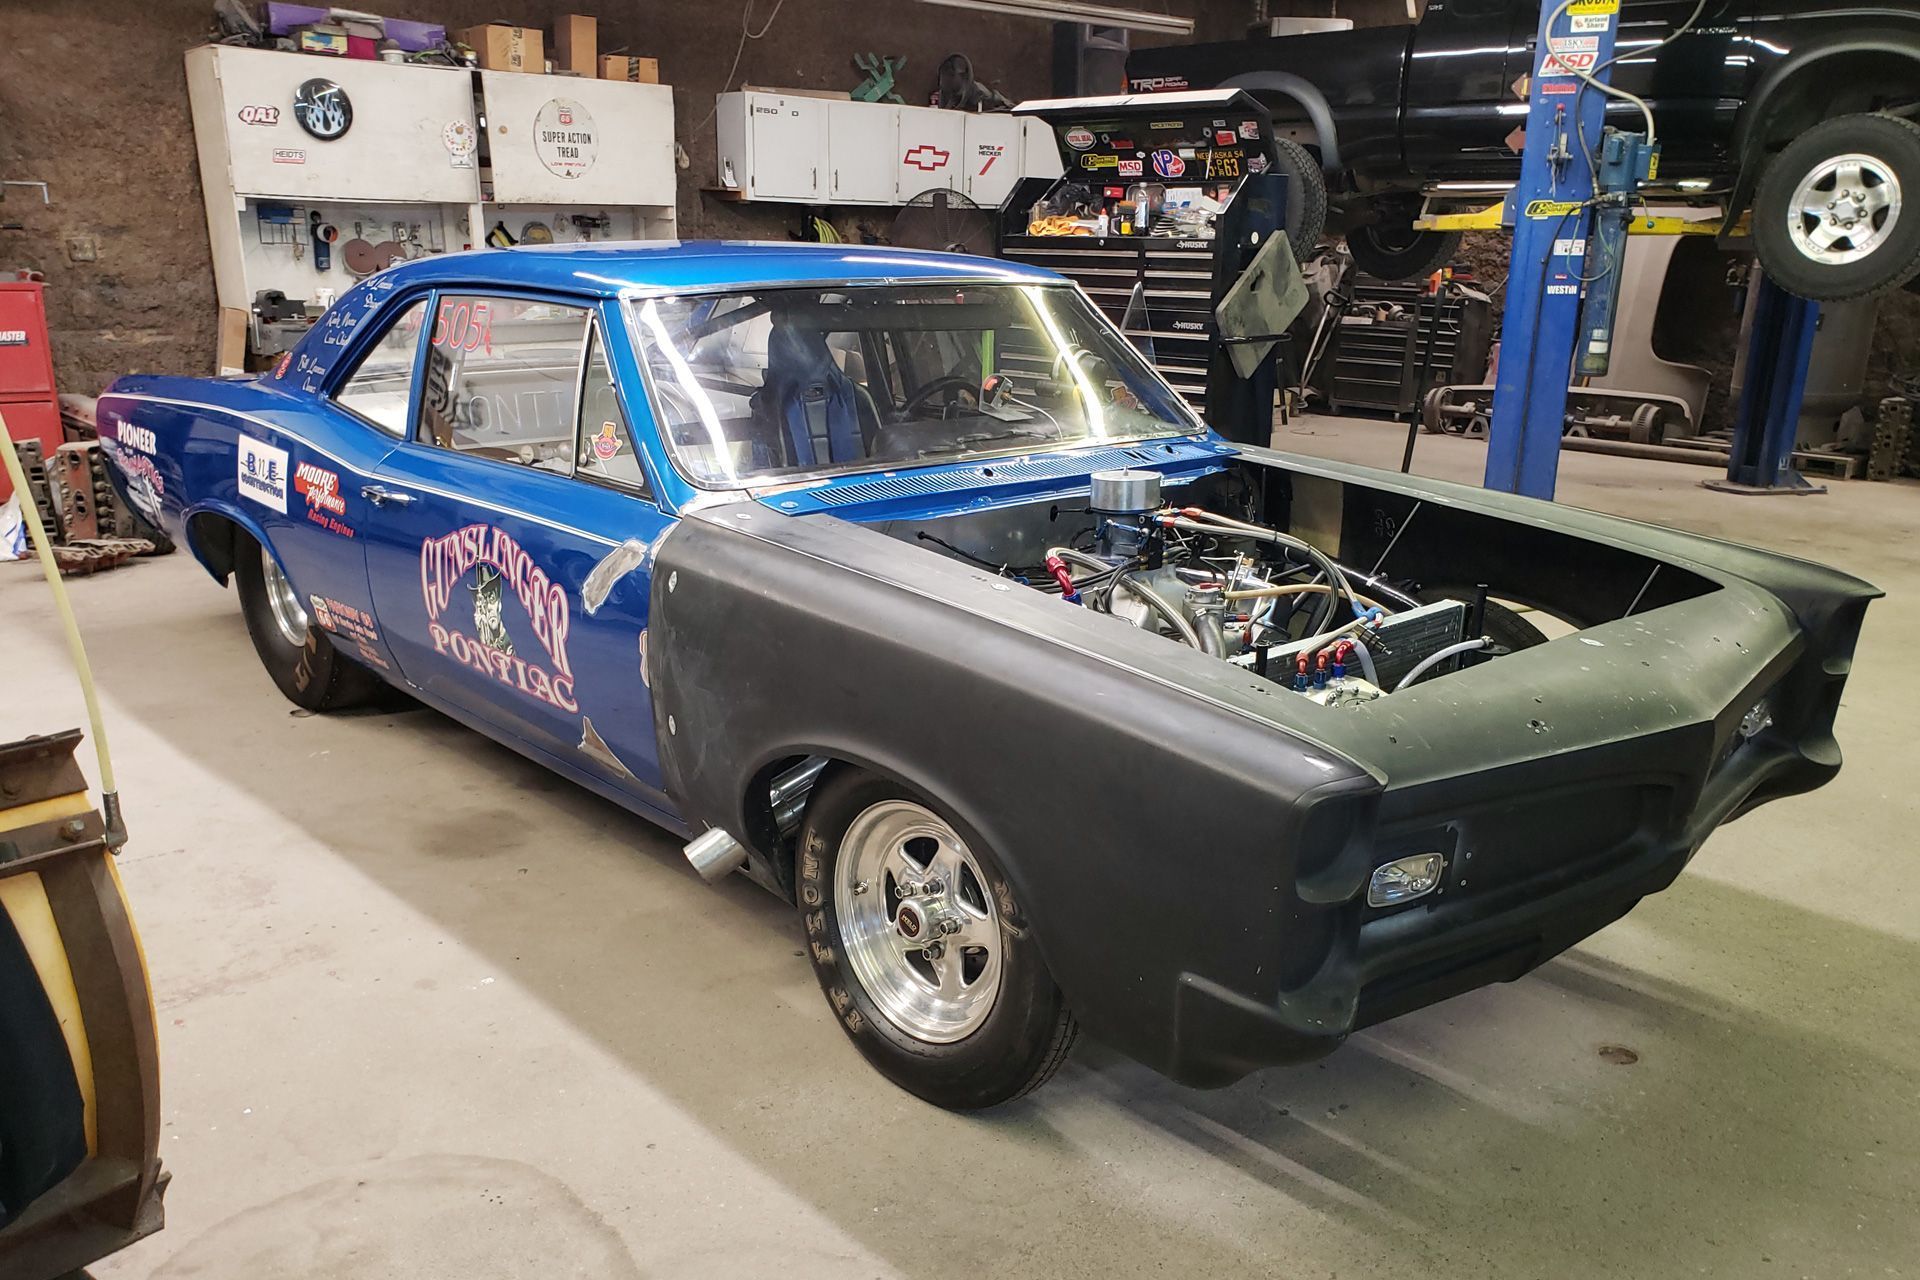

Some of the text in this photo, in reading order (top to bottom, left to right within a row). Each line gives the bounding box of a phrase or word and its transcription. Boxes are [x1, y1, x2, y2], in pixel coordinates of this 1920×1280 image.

[1545, 54, 1594, 68] MSD
[1131, 78, 1163, 91] TRD
[242, 105, 278, 124] QA1
[542, 131, 592, 144] SUPER ACTION
[557, 147, 579, 158] TREAD
[1196, 151, 1233, 159] NEBRASKA
[1120, 161, 1141, 171] MSD
[1151, 150, 1174, 177] VP
[1224, 159, 1239, 177] 63
[1547, 285, 1577, 294] WESTIN
[1180, 322, 1204, 330] HUSKY
[117, 420, 157, 456] PIONEER
[247, 452, 256, 474] B
[267, 460, 278, 483] E
[296, 463, 337, 493] MOORE
[307, 508, 354, 537] Racing Engines
[420, 524, 574, 683] GUNSLINGER
[428, 621, 580, 714] PONTIAC
[802, 828, 832, 962] FRONT
